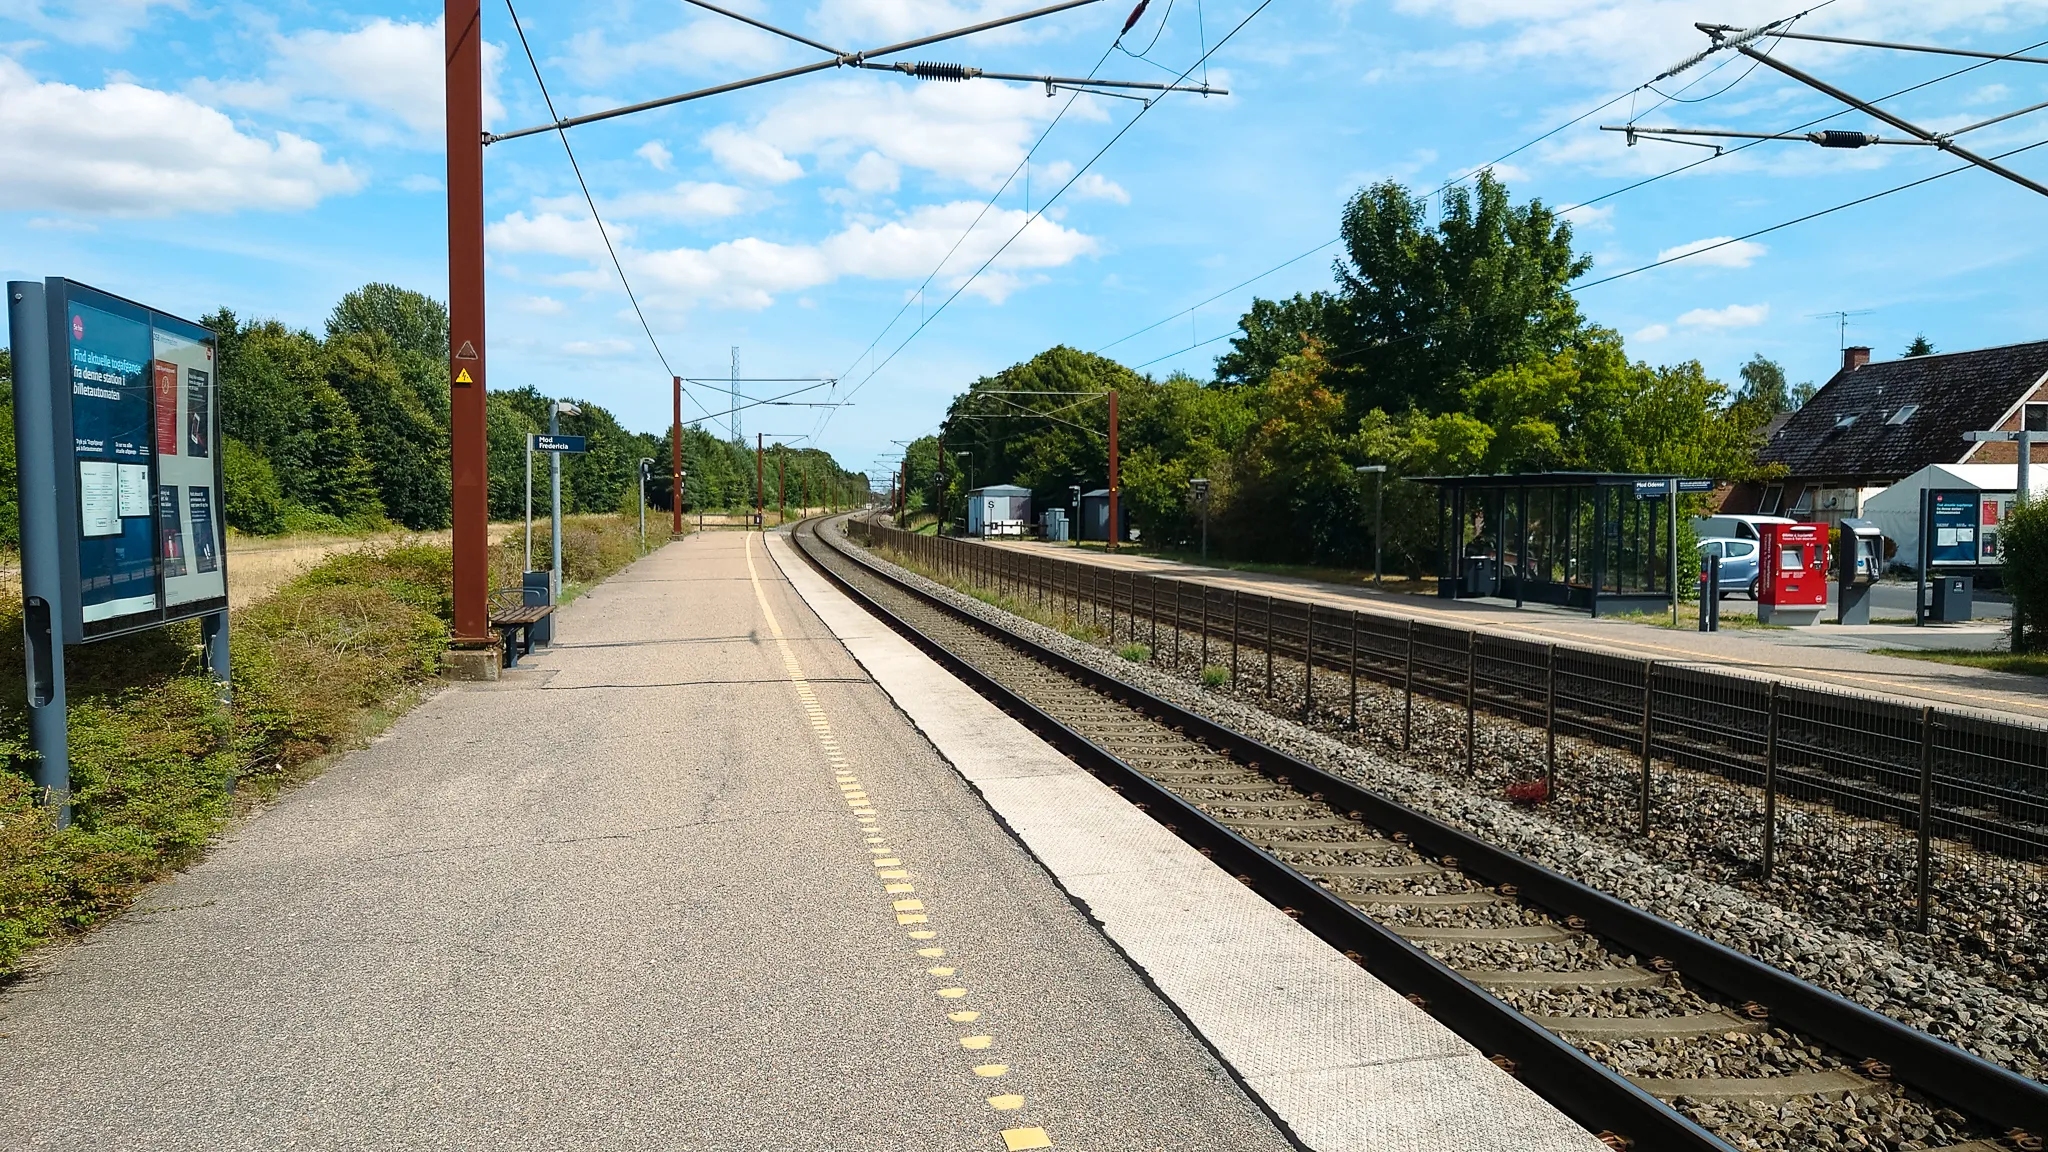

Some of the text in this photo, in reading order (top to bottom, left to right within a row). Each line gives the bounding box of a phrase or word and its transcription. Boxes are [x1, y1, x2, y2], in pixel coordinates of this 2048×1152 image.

[73, 348, 87, 362] Find
[87, 352, 111, 367] aktuelle
[111, 359, 142, 375] togafgange
[73, 365, 126, 386] fra denne station i
[73, 381, 121, 401] billetautomaten
[538, 442, 569, 450] Fredericia
[988, 500, 995, 509] S
